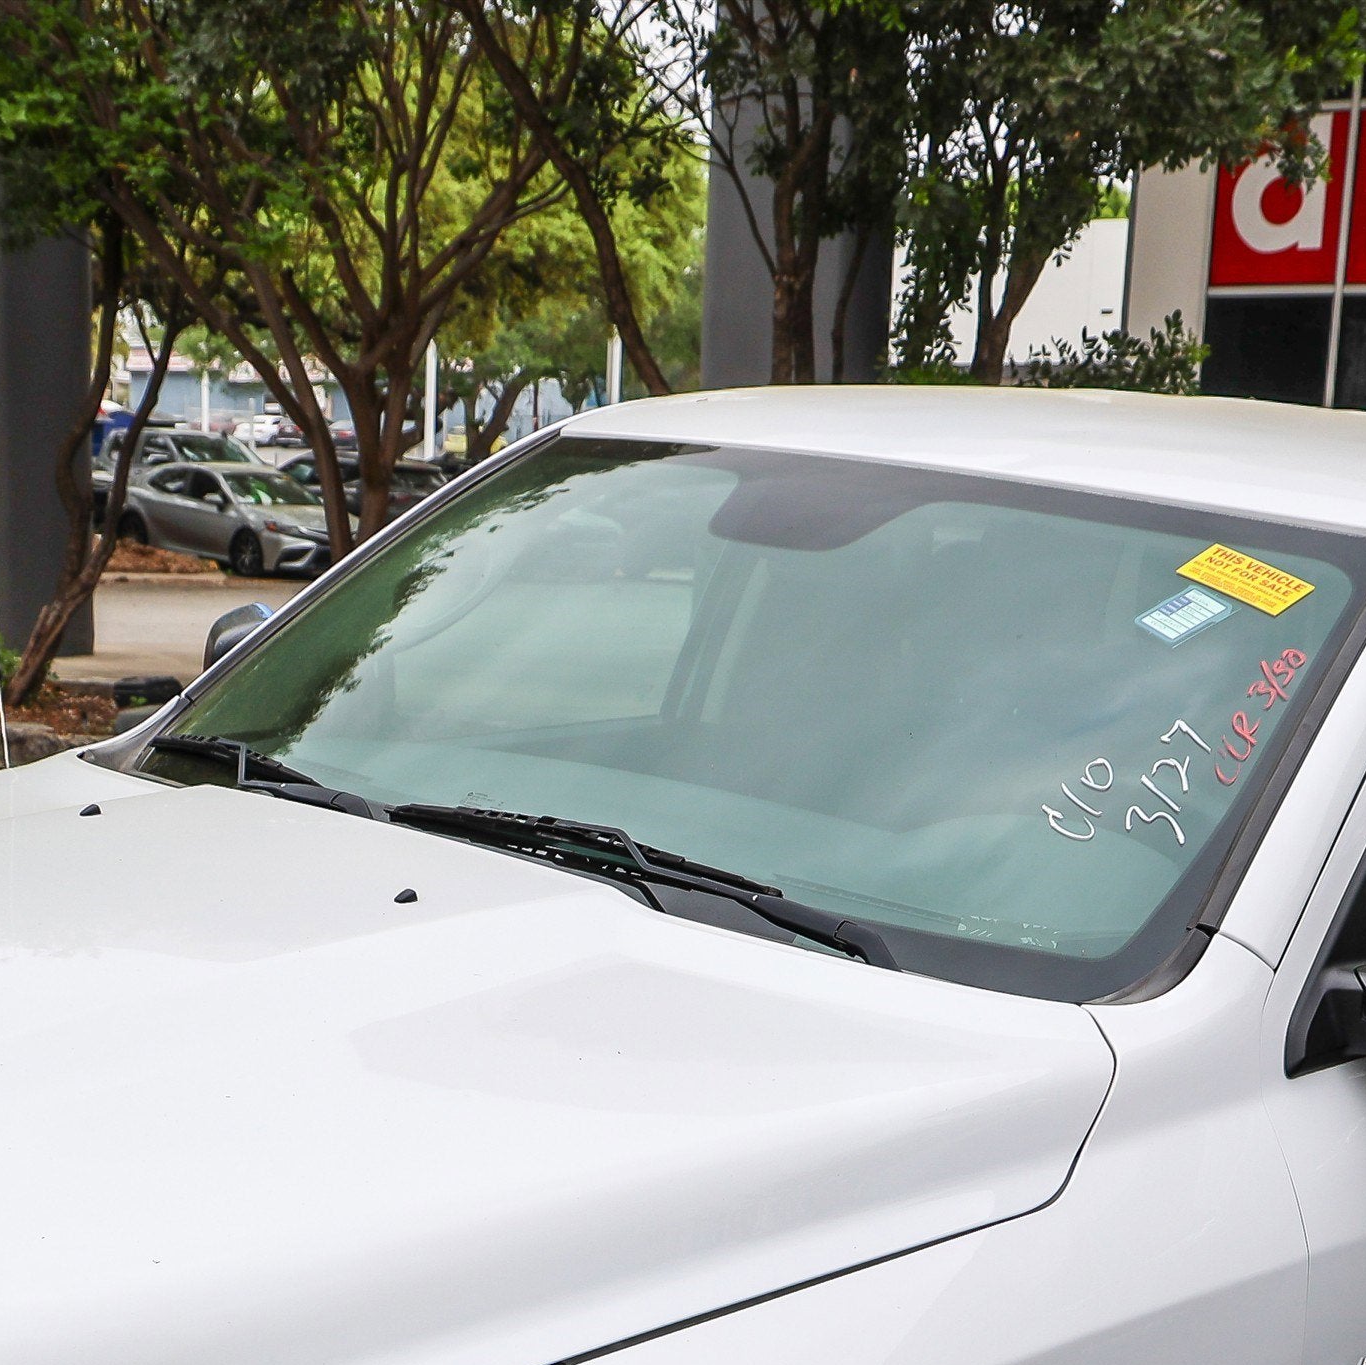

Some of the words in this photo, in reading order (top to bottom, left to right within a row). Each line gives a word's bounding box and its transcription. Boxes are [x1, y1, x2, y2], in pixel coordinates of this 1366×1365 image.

[1204, 556, 1233, 569] NOT
[1231, 566, 1260, 582] FOR
[1258, 578, 1295, 597] SALE
[1211, 547, 1246, 566] THIS
[1246, 561, 1308, 593] VEHICLE
